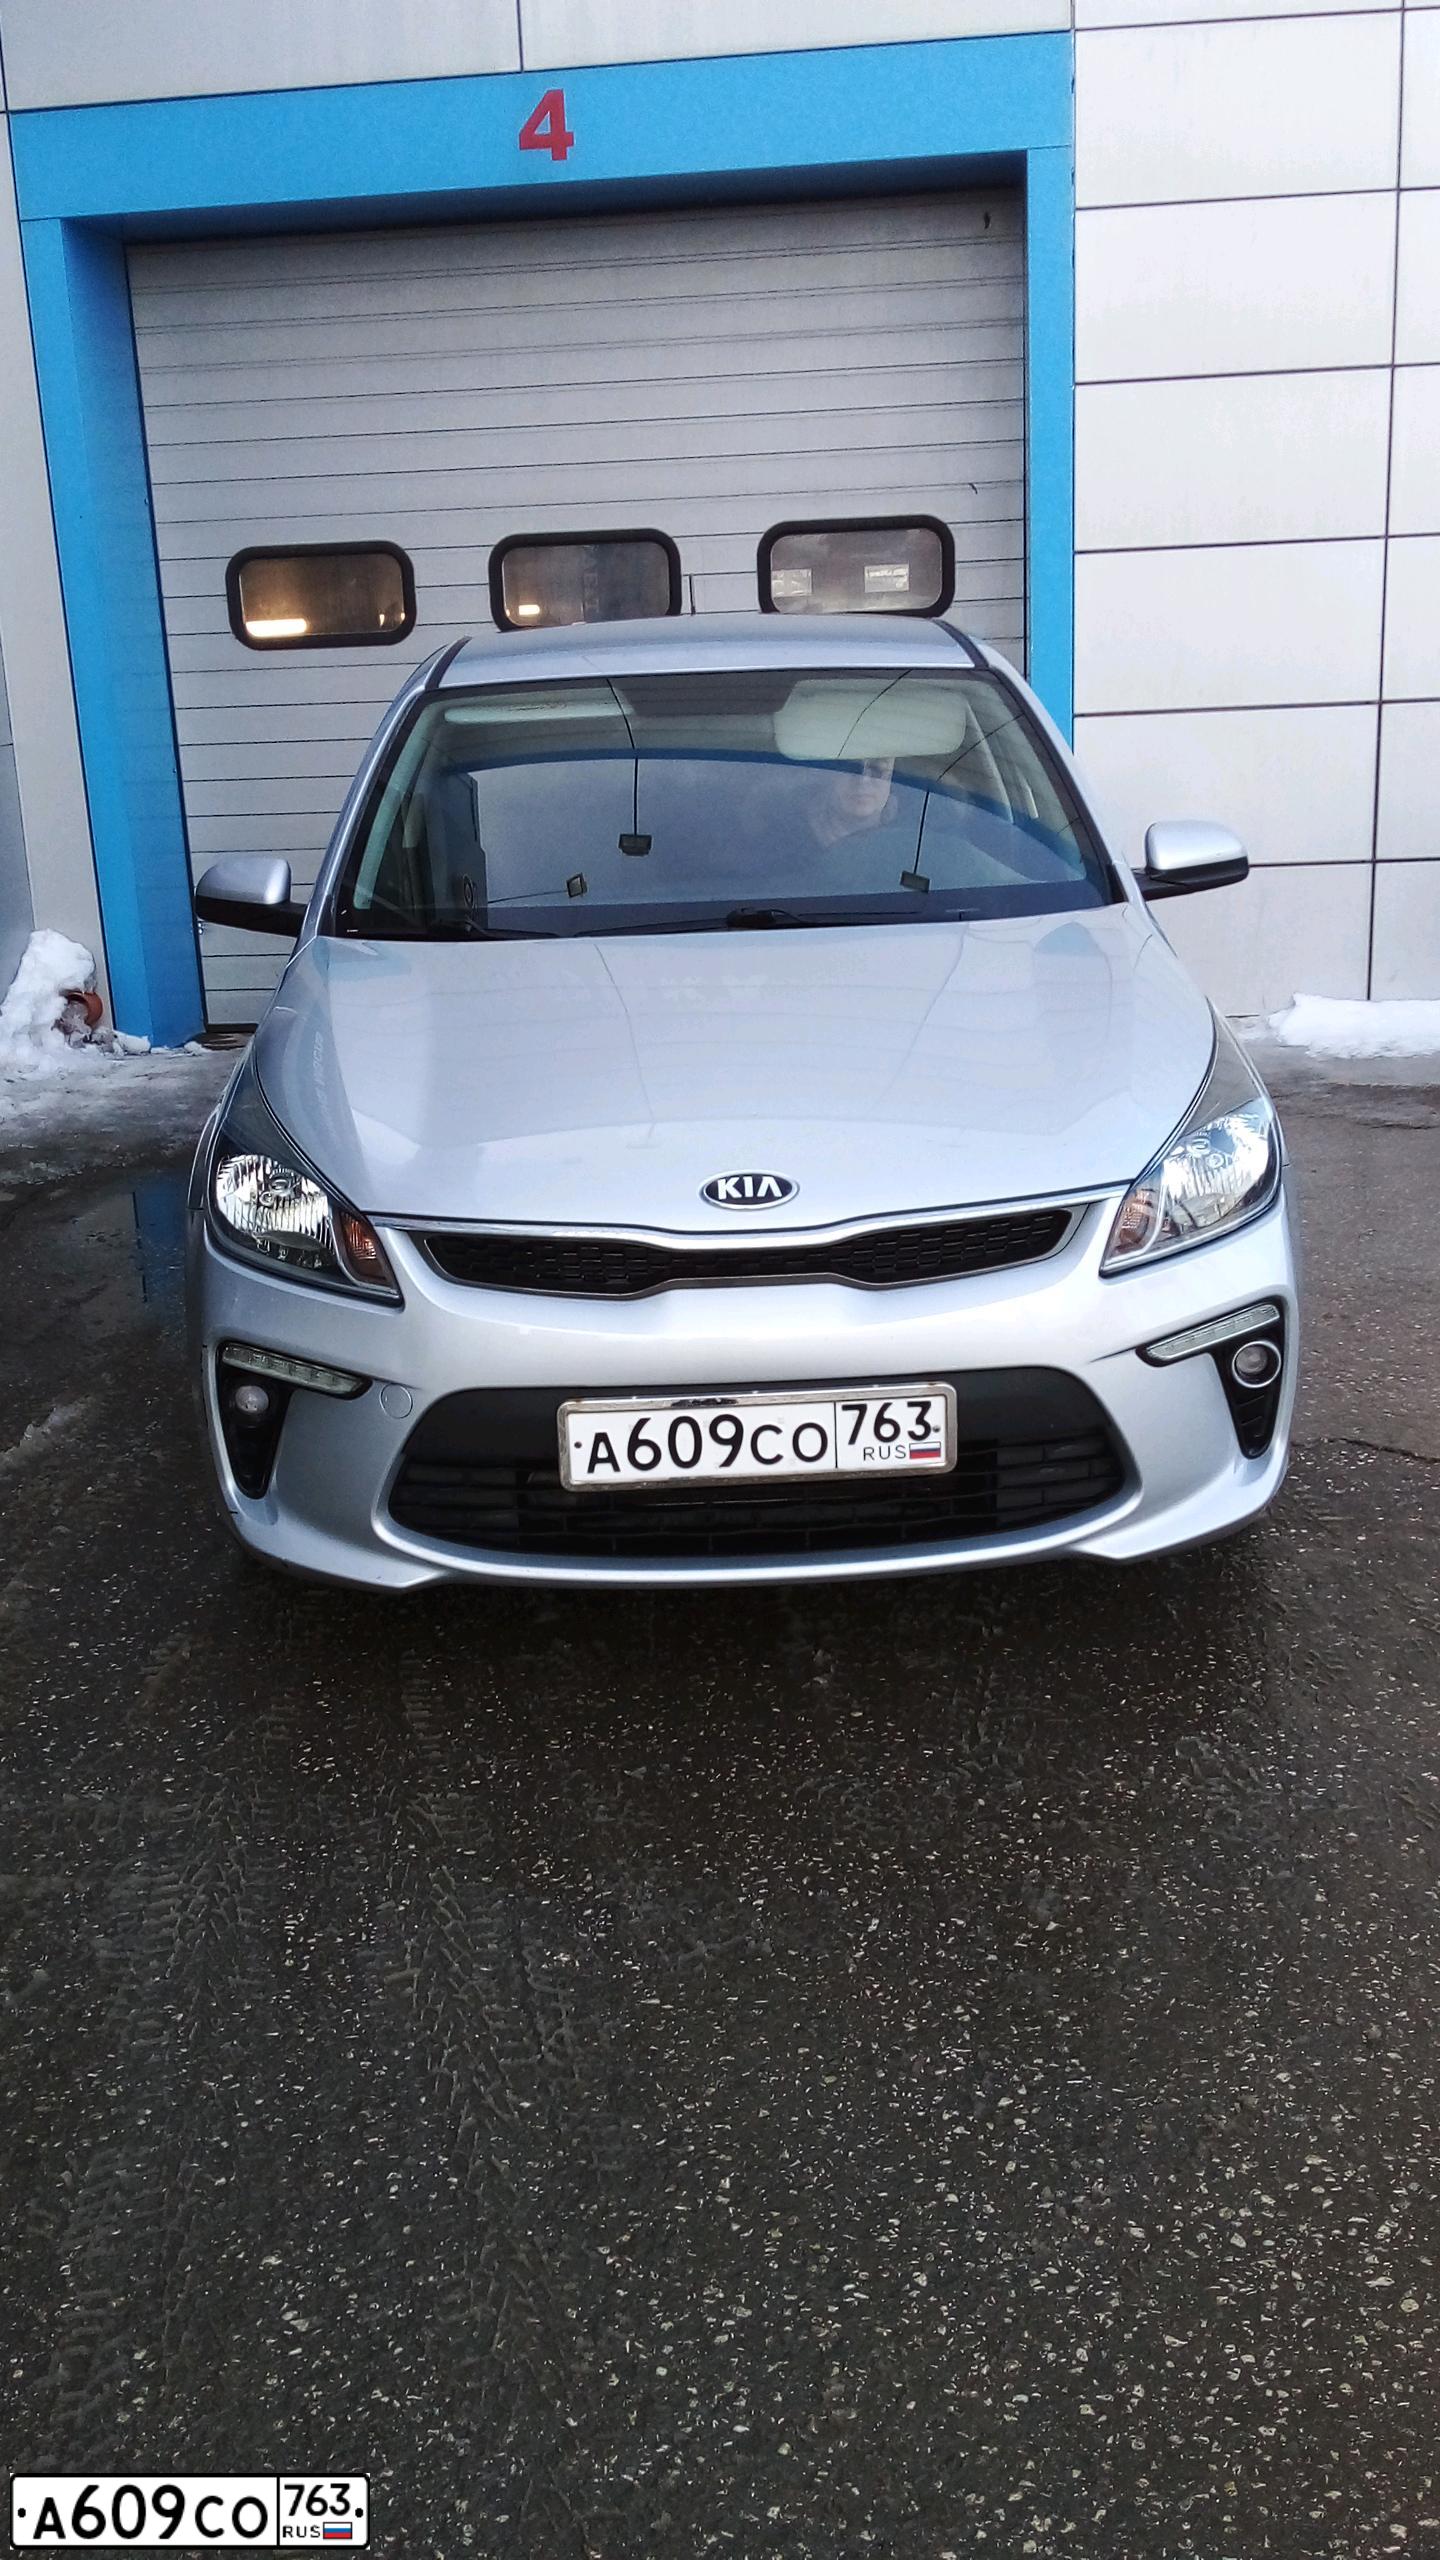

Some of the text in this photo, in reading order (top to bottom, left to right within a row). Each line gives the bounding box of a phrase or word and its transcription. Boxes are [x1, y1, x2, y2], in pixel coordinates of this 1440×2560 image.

[519, 88, 574, 161] 4
[717, 1176, 782, 1200] KIA
[841, 1401, 932, 1445] 763
[863, 1445, 906, 1461] RUS
